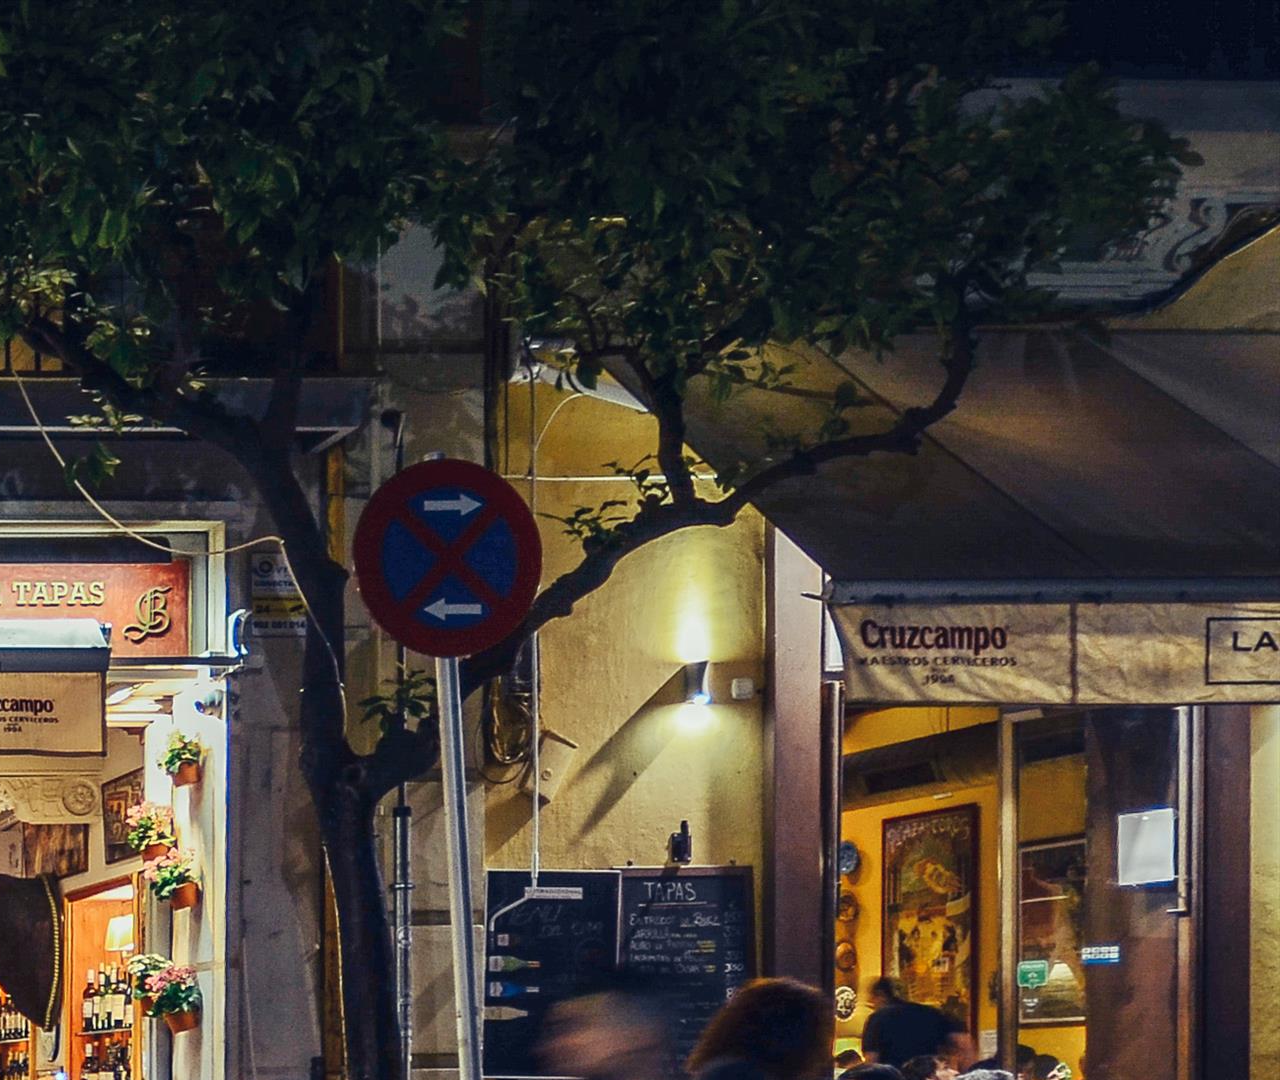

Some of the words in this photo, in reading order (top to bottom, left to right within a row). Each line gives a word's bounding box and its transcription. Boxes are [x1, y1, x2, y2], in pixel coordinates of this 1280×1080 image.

[12, 580, 106, 607] TAPAS
[860, 619, 1009, 656] Cruzcampo
[1232, 631, 1279, 652] LA
[858, 656, 929, 666] MAESTROS
[643, 881, 697, 901] TAPAS
